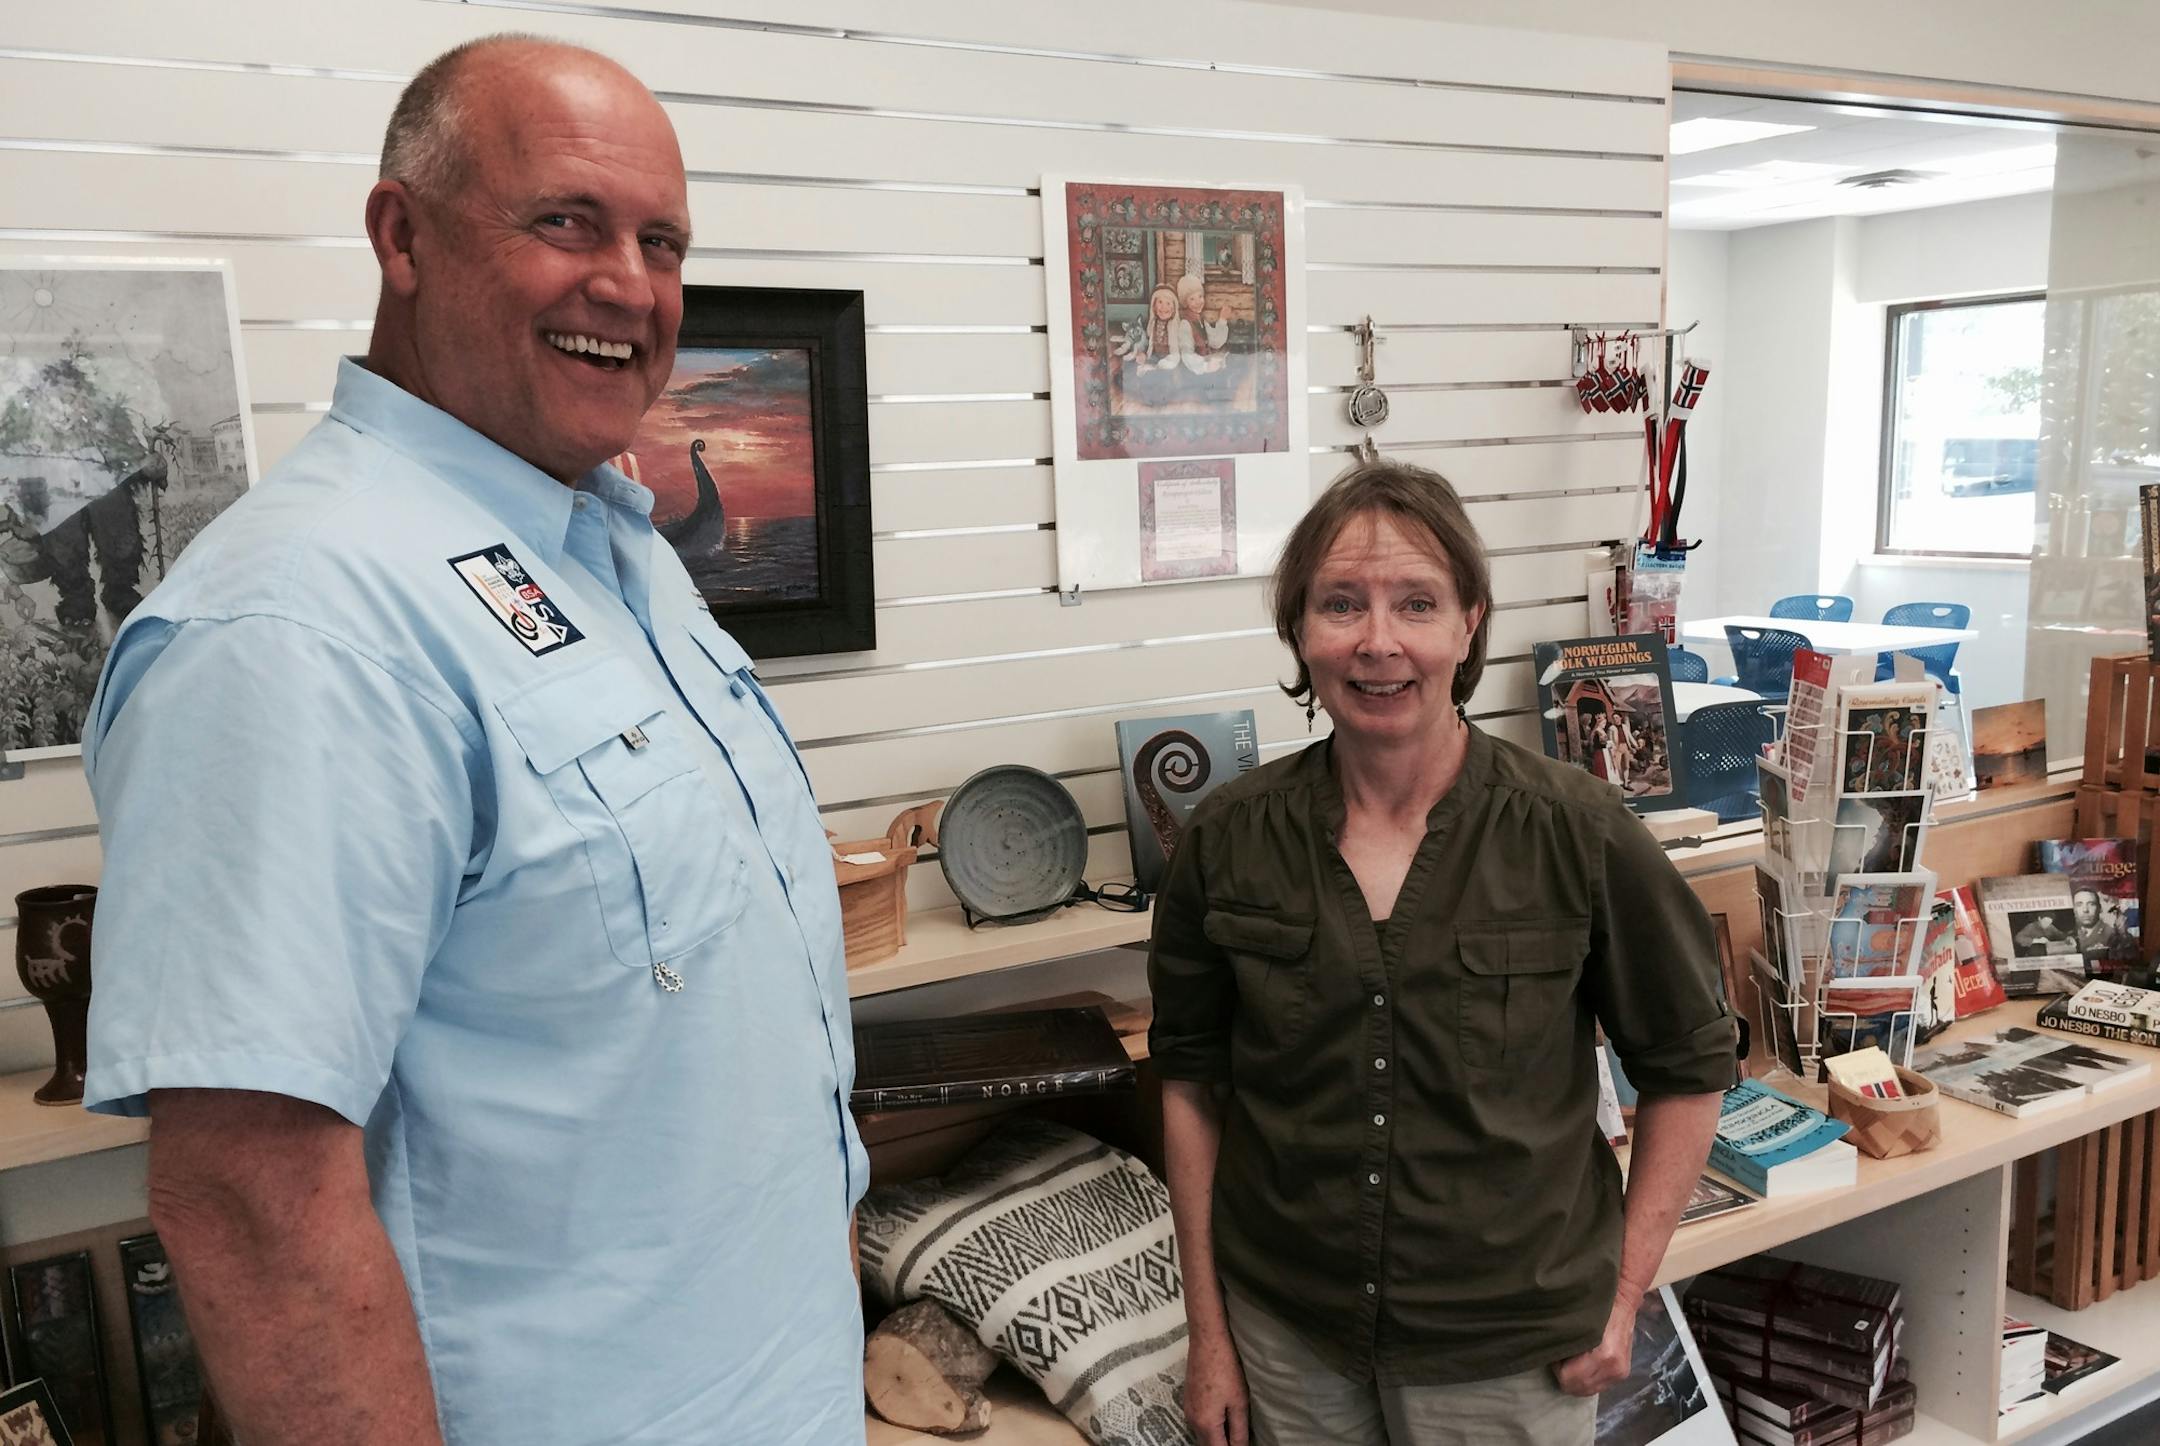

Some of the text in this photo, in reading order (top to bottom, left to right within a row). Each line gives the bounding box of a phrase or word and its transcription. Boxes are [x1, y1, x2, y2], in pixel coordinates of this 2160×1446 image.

[1563, 641, 1638, 658] NORWEGIAN
[1586, 651, 1653, 668] WEDDINGS
[1233, 720, 1253, 751] THE
[2071, 1005, 2087, 1017] JO
[2041, 1016, 2058, 1027] JO
[2103, 1025, 2129, 1041] THE
[2130, 1030, 2158, 1046] SON
[981, 1080, 1064, 1098] NORGE
